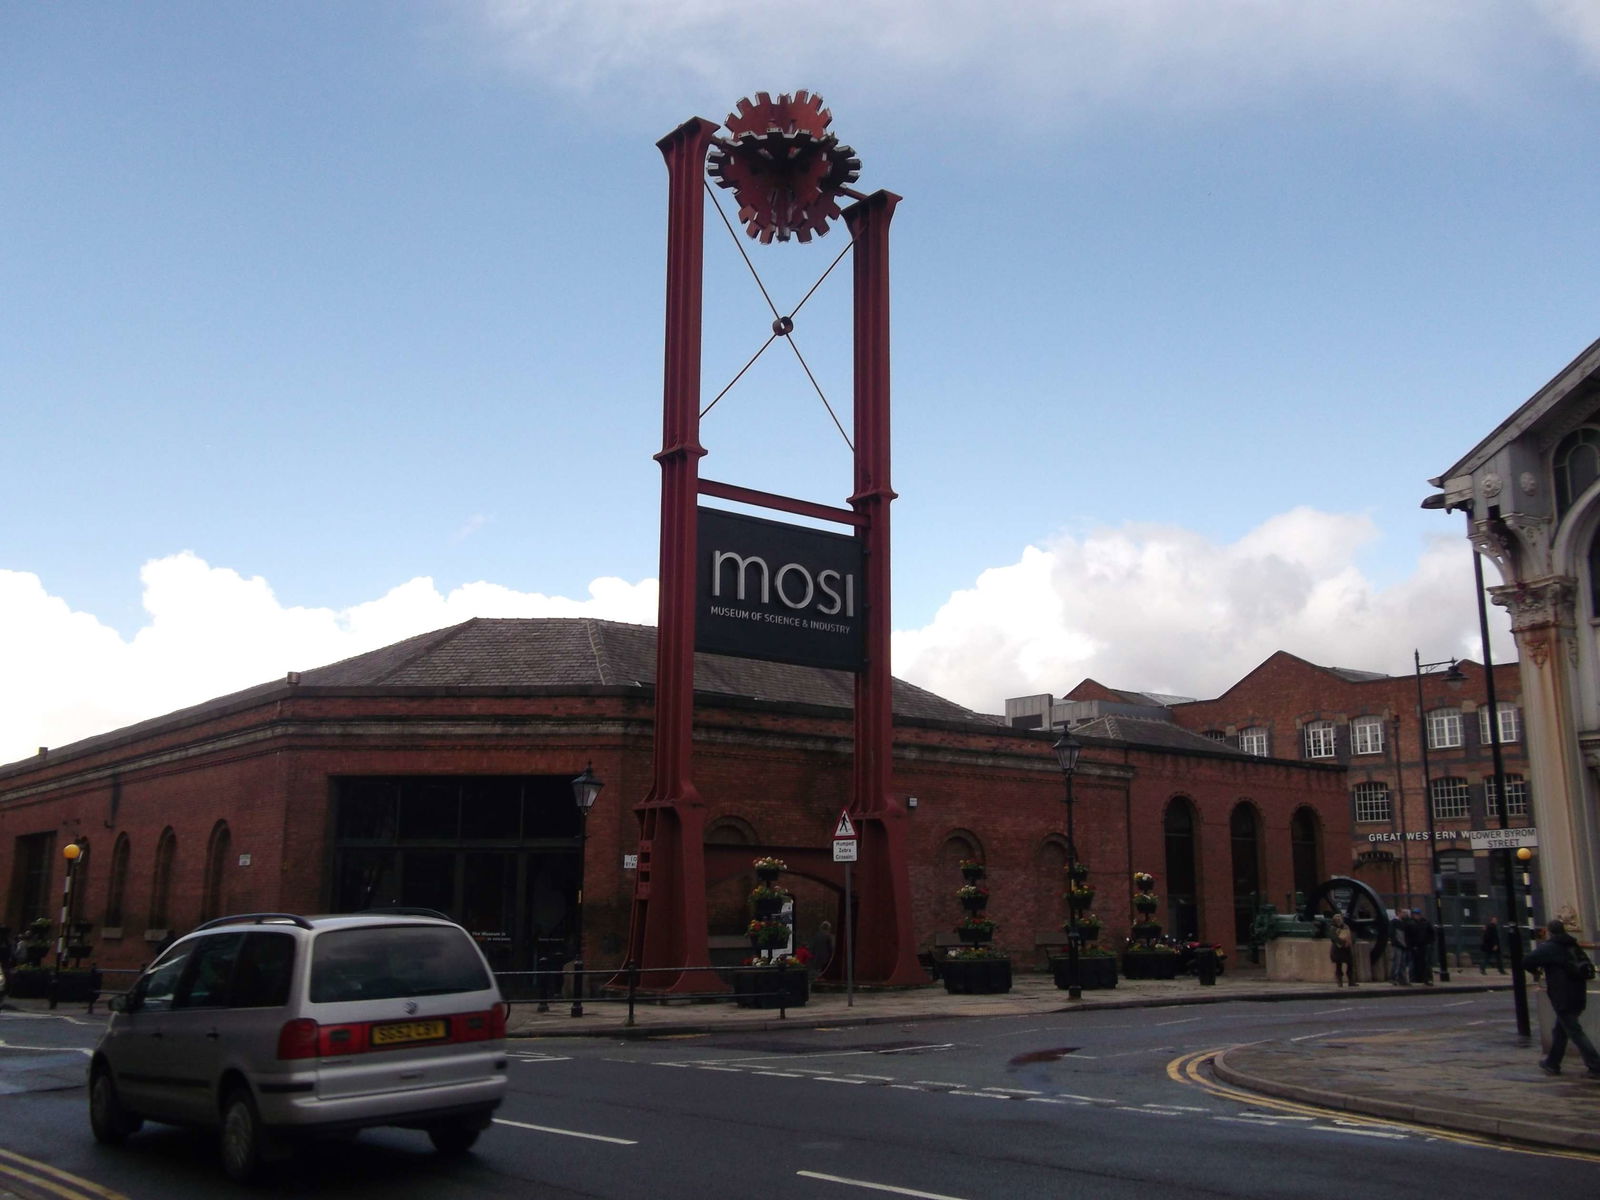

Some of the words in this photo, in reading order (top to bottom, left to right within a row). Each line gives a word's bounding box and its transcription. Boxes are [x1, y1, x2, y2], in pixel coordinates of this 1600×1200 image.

[711, 606, 749, 621] MUSEUM
[751, 612, 762, 622] OF
[764, 613, 800, 627] SCIENCE
[802, 619, 808, 628] &
[810, 620, 850, 634] INDUSTRY
[1368, 832, 1401, 842] GREAT
[1406, 831, 1456, 841] WESERN
[1472, 830, 1501, 839] LOWER
[1504, 828, 1536, 838] BYROM
[1488, 839, 1520, 848] STREET
